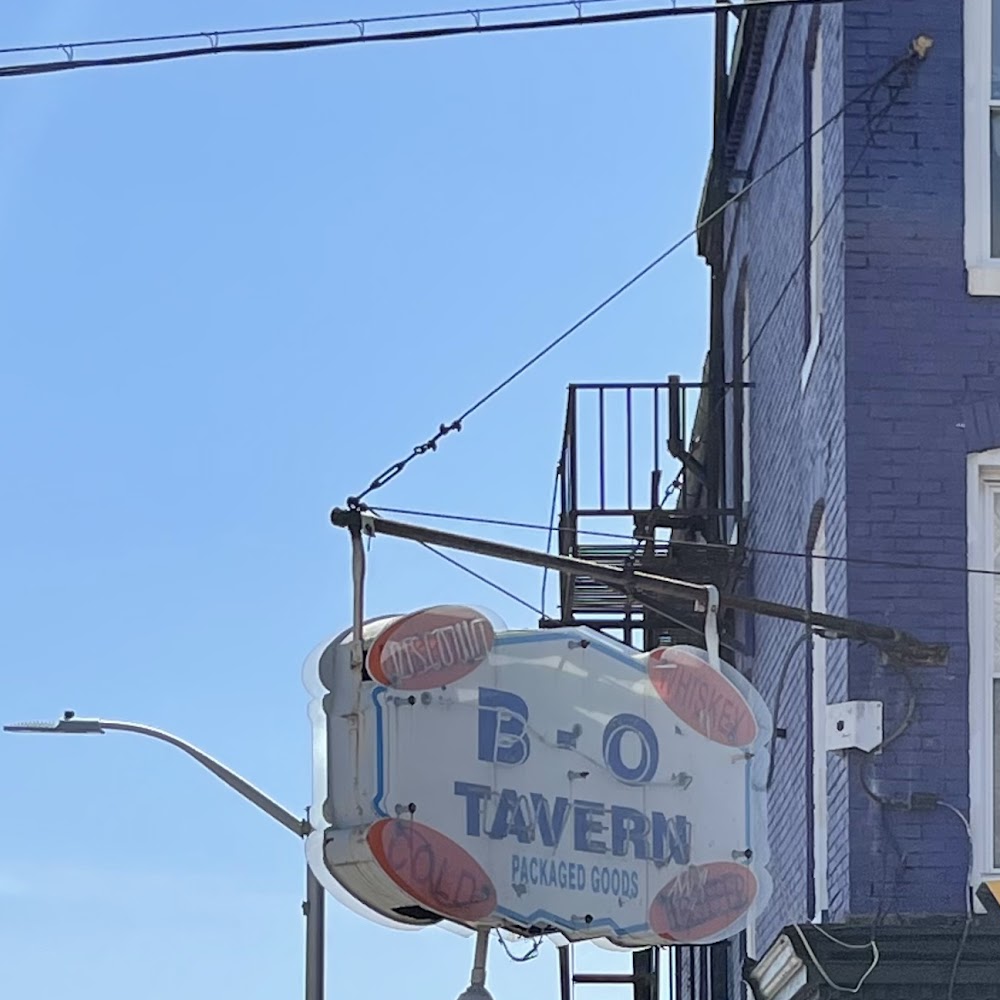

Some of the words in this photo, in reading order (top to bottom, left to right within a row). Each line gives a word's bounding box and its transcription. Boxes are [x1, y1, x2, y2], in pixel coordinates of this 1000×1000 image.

[454, 781, 692, 869] TAVERN
[512, 855, 586, 892] PACKAGED
[591, 866, 639, 898] GOODS
